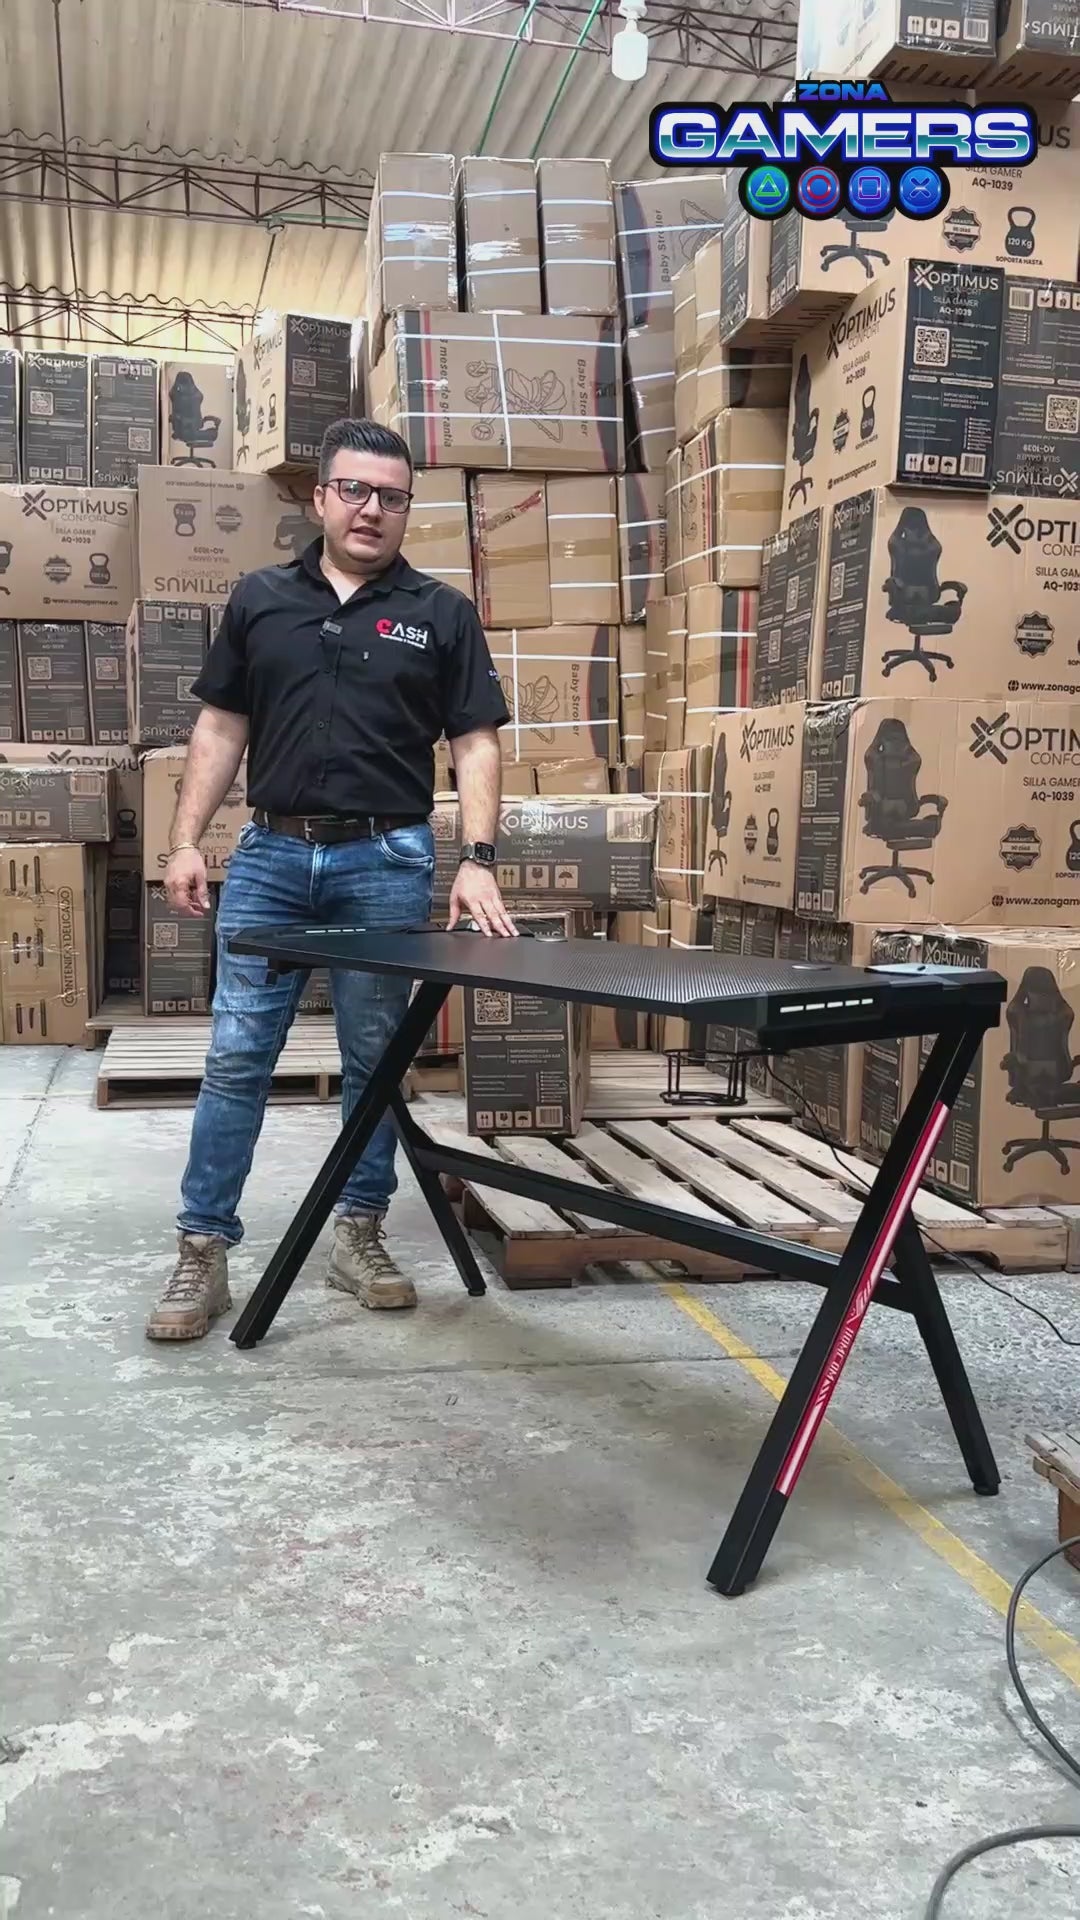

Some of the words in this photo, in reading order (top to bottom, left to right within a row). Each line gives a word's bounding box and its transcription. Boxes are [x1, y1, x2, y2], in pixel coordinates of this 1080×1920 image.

[1031, 20, 1080, 38] TIMUS
[971, 176, 1014, 191] AQ-1039
[1007, 237, 1021, 247] 120
[1021, 238, 1033, 250] Kg
[659, 254, 671, 284] Baby
[939, 306, 973, 317] AQ-1039
[576, 358, 590, 389] Baby
[98, 473, 137, 485] PTIMUS
[1035, 566, 1059, 577] SILLA
[1043, 580, 1080, 593] AQ-103
[375, 618, 428, 645] CASH
[569, 663, 581, 693] Baby
[1023, 776, 1047, 787] SILLA
[1030, 790, 1075, 802] AQ-1039
[60, 890, 72, 942] DELICADO
[298, 1000, 331, 1009] TIMUS
